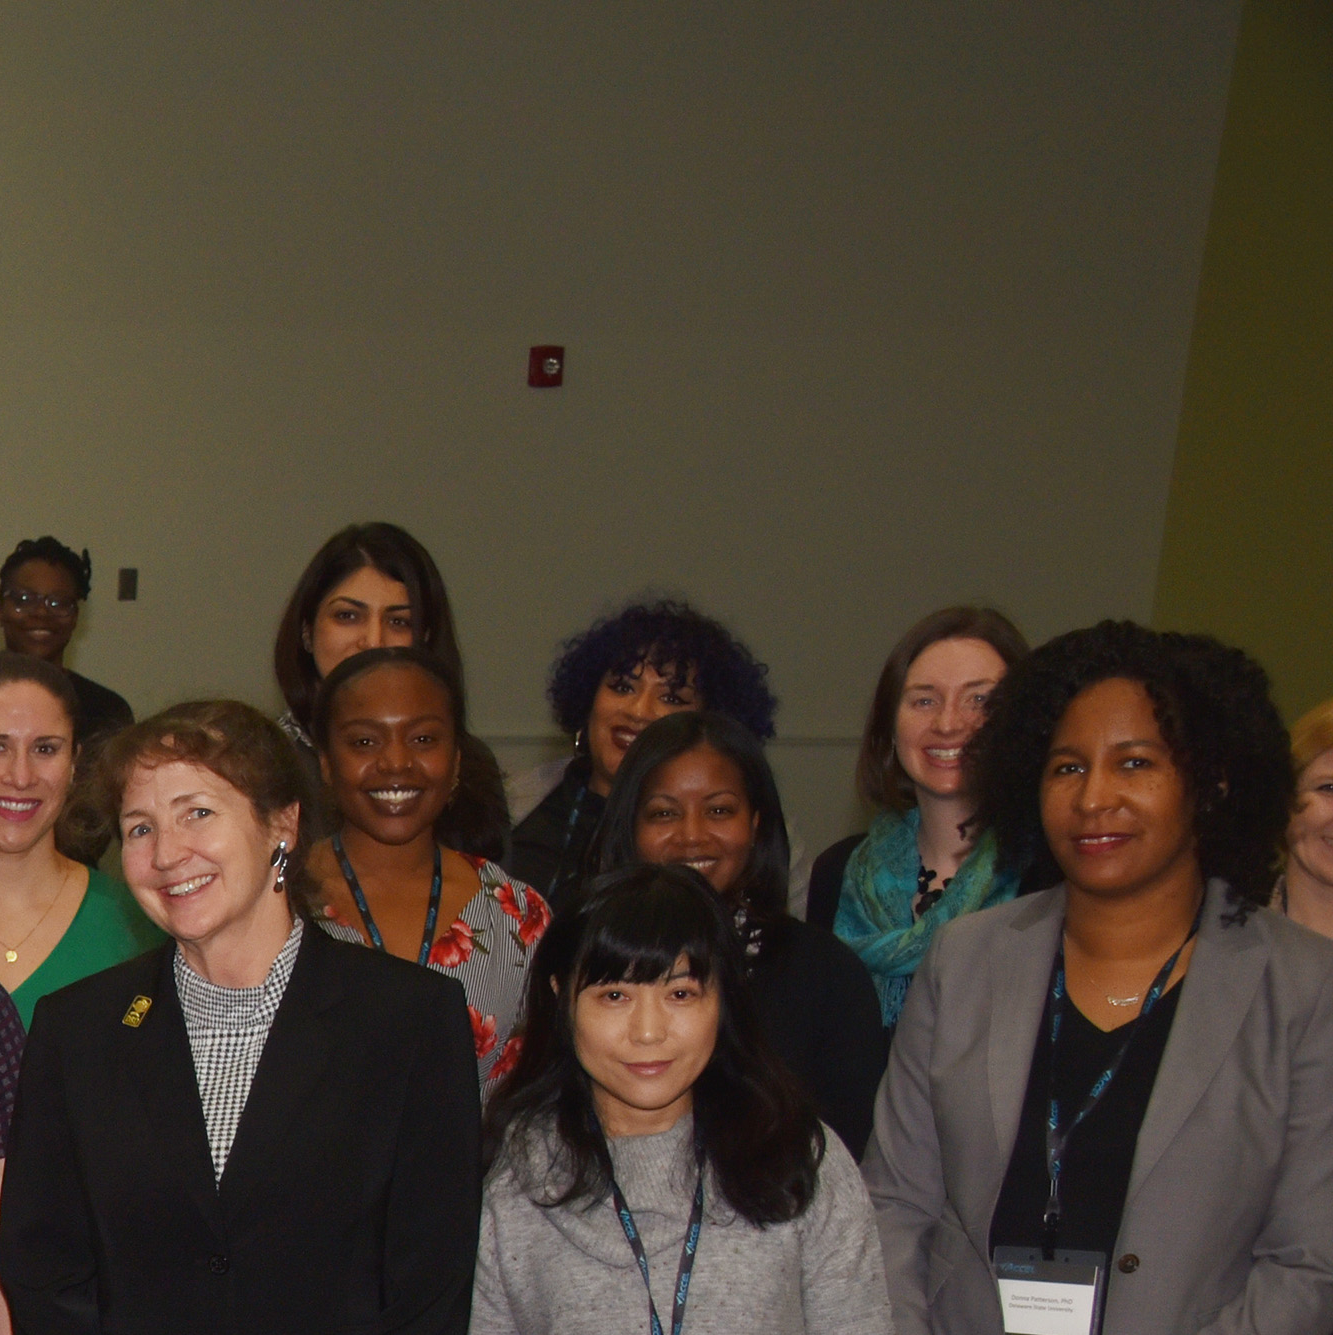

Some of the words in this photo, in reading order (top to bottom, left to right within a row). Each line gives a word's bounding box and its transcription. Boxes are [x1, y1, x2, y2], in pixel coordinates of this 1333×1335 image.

[687, 1223, 699, 1251] ACCEL
[677, 1273, 690, 1301] ACCEL
[1048, 1305, 1074, 1313] University
[1061, 1297, 1073, 1305] PhD
